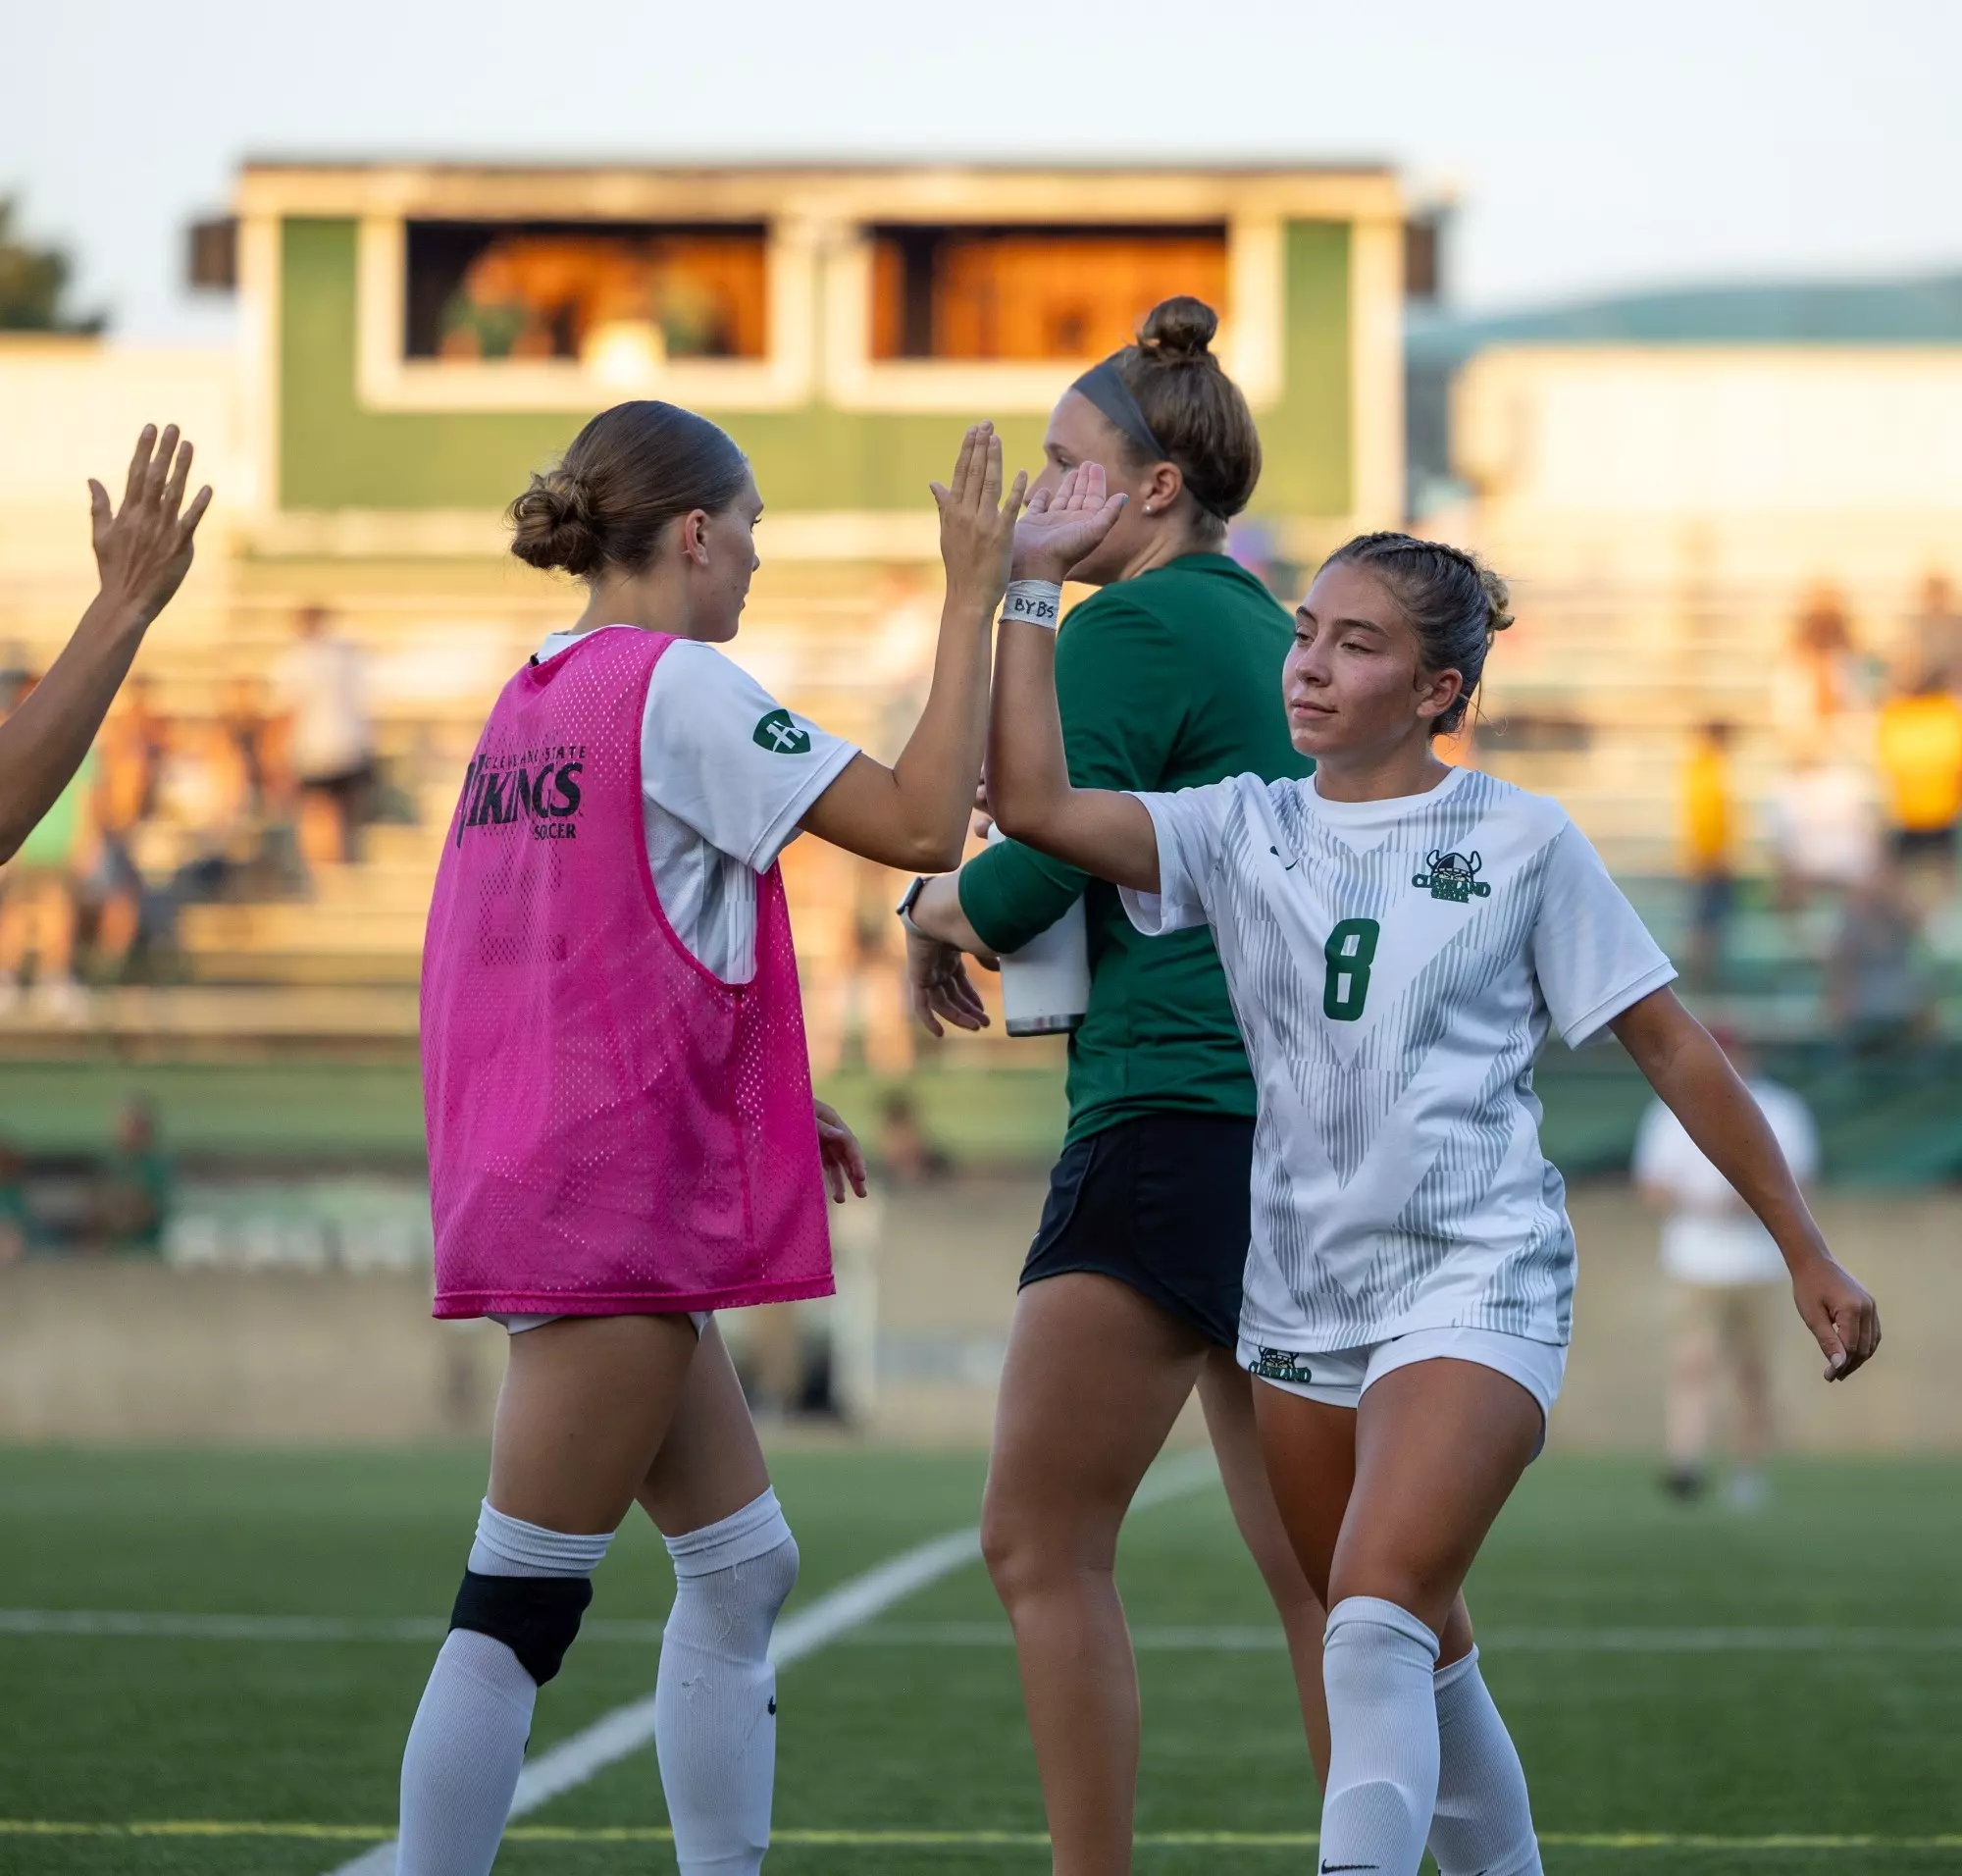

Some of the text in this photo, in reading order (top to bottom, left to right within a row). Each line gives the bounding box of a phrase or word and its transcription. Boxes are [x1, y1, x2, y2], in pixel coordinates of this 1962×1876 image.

[1014, 598, 1055, 618] BYBS
[456, 753, 584, 849] VIKINGS
[534, 822, 577, 841] SOCER
[1323, 917, 1380, 1021] 8
